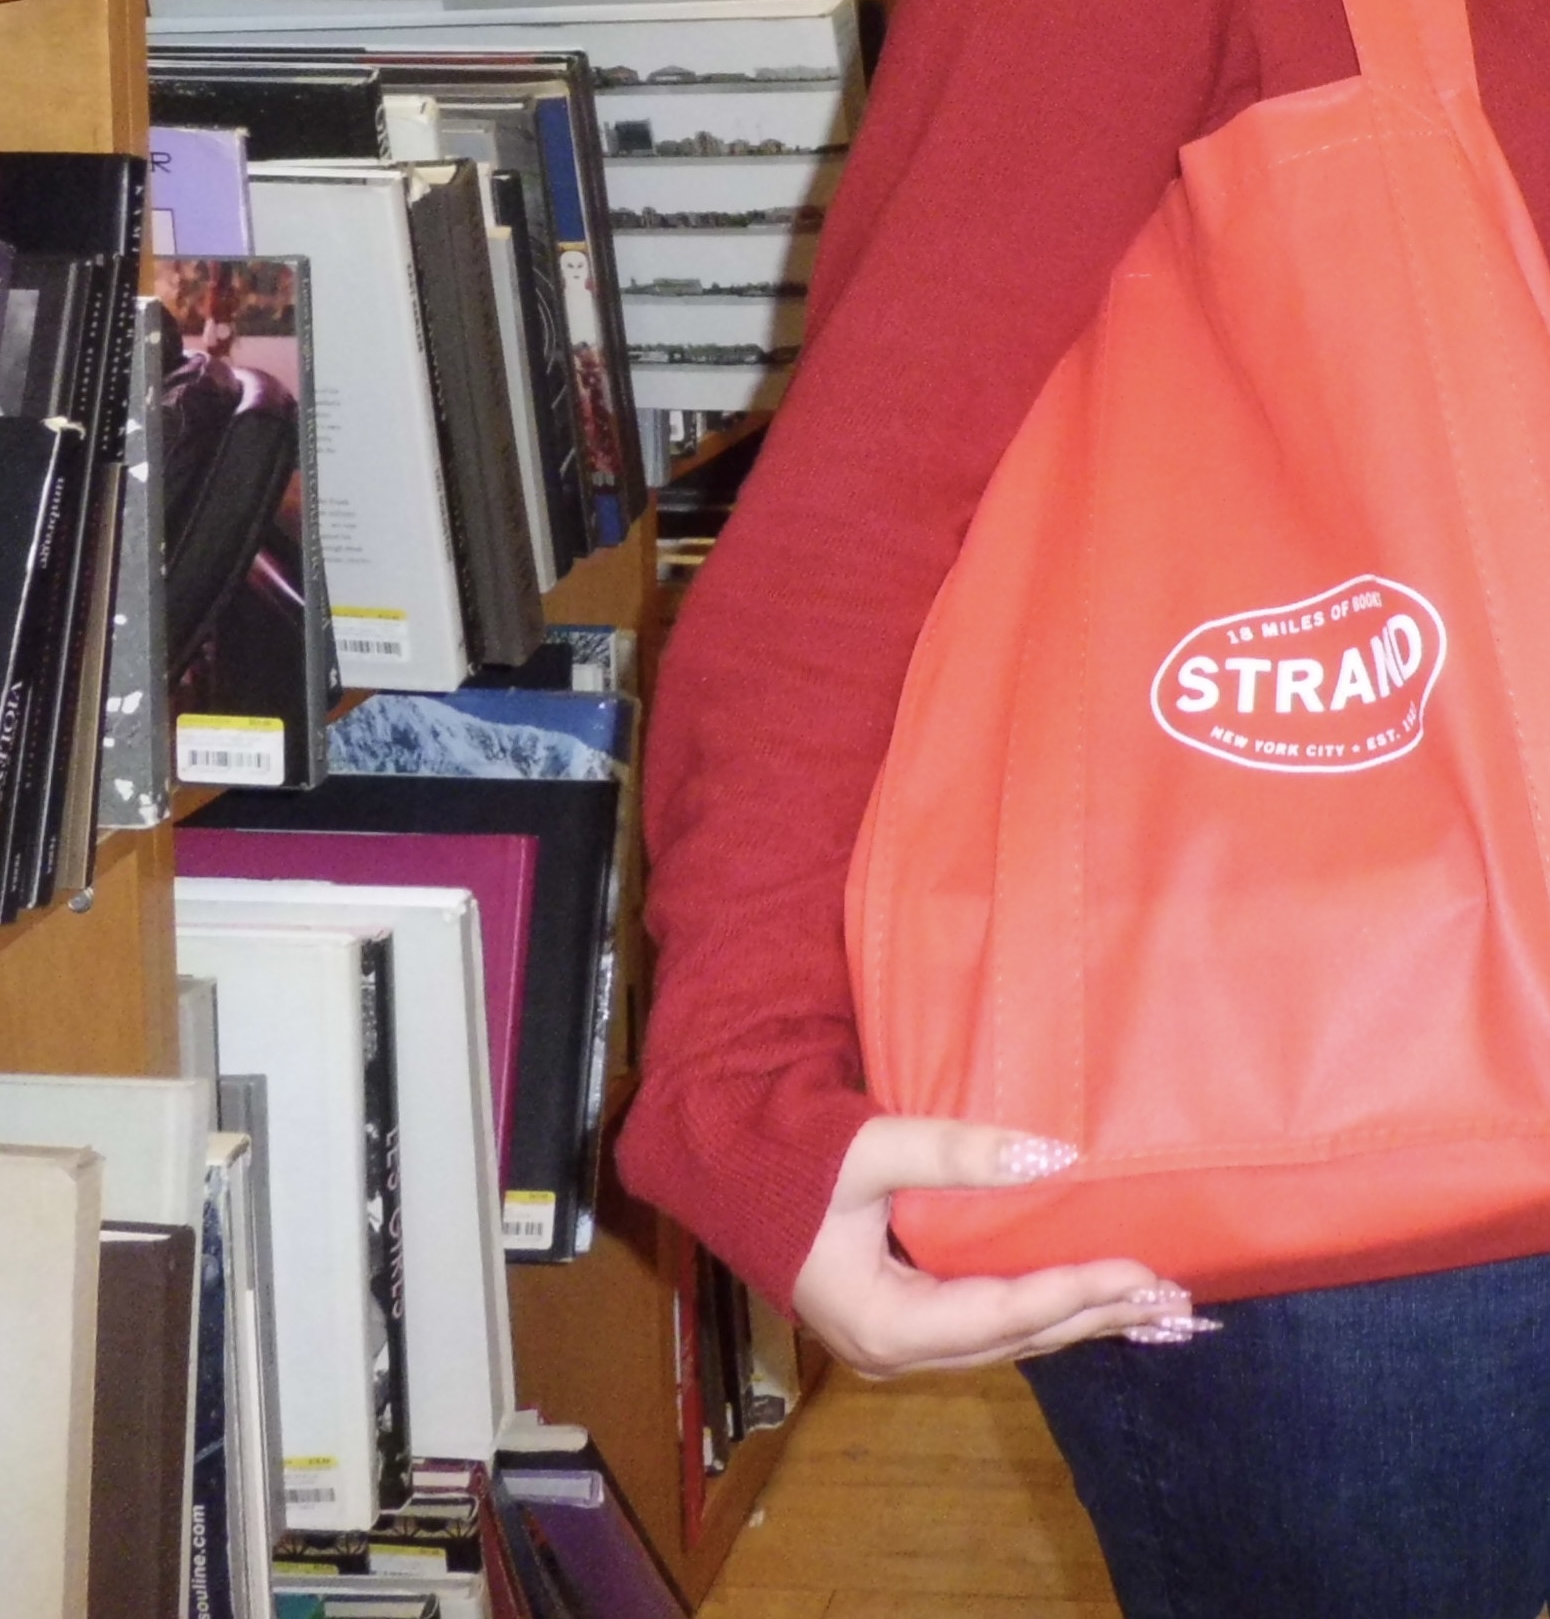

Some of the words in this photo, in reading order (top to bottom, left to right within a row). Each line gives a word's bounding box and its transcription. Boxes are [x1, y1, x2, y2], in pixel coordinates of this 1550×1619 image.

[40, 477, 65, 569] umbrage
[1226, 626, 1254, 644] 18
[1262, 612, 1325, 637] MILES
[1331, 600, 1350, 621] OF
[1176, 614, 1422, 713] STRAND
[1211, 725, 1247, 749] NEW
[1255, 739, 1299, 756] YORK
[1306, 742, 1345, 757] CITY
[1367, 728, 1400, 751] EST.
[386, 1127, 401, 1192] LES
